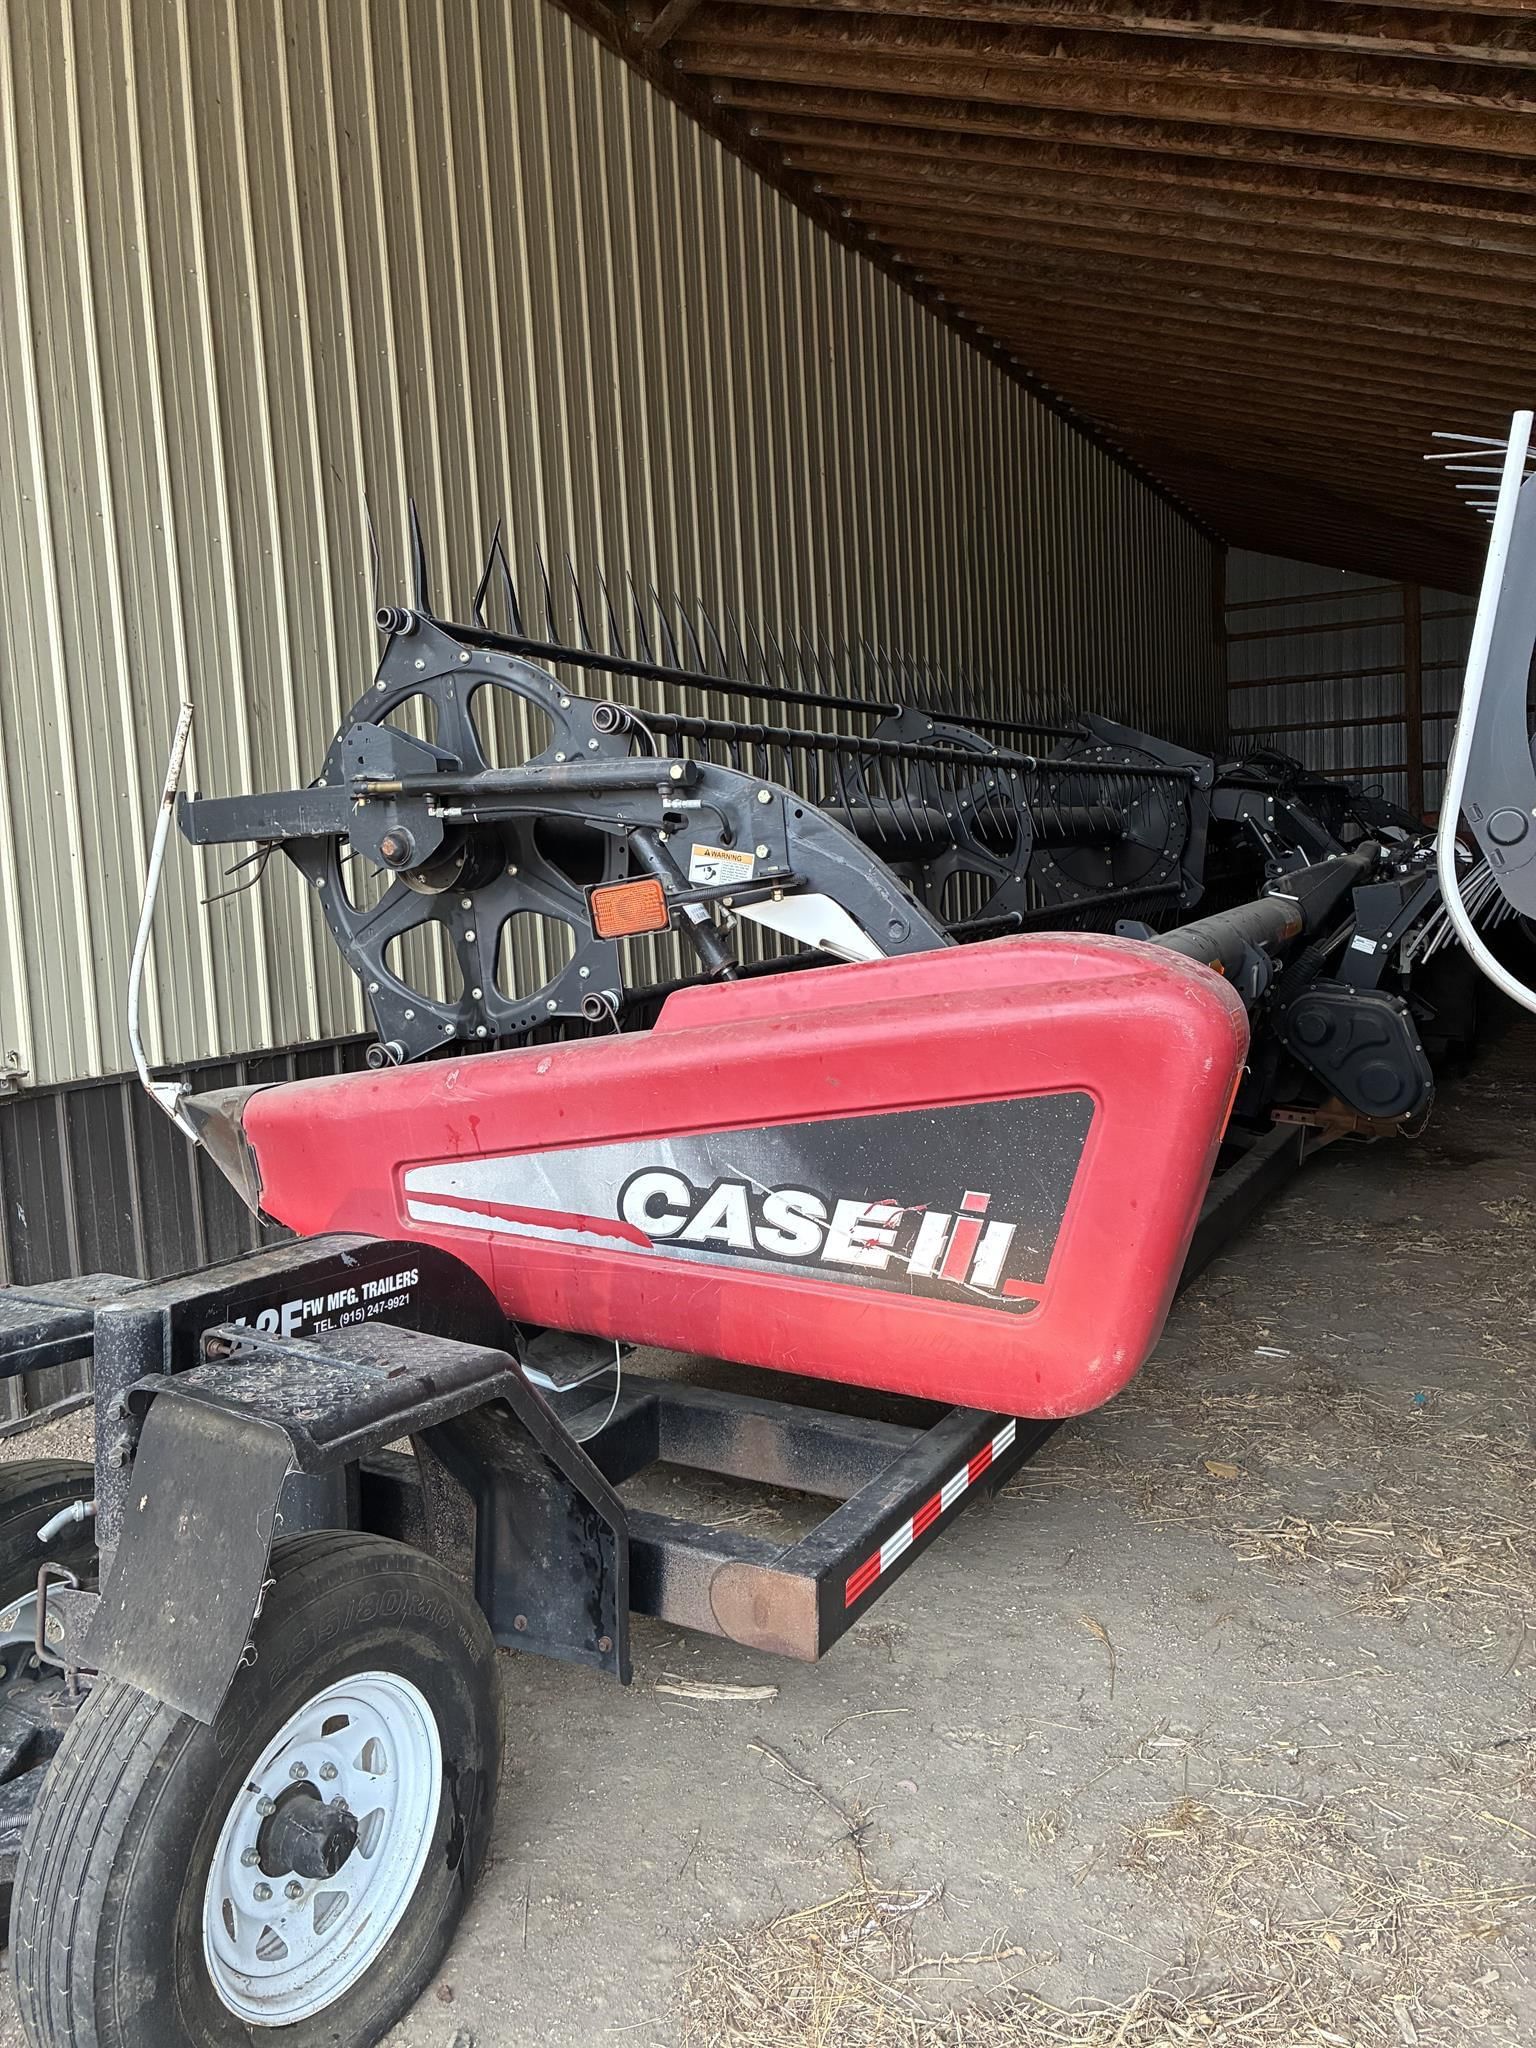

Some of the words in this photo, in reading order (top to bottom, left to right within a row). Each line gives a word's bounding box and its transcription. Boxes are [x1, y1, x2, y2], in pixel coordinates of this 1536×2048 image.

[711, 851, 743, 862] WARNING
[618, 1167, 904, 1271] CASE
[303, 1297, 324, 1319] FW
[327, 1287, 359, 1311] MFG.
[361, 1268, 419, 1300] TRAILERS
[313, 1318, 337, 1333] TEL.
[340, 1308, 365, 1328] (915)
[367, 1293, 410, 1317] 247-9921
